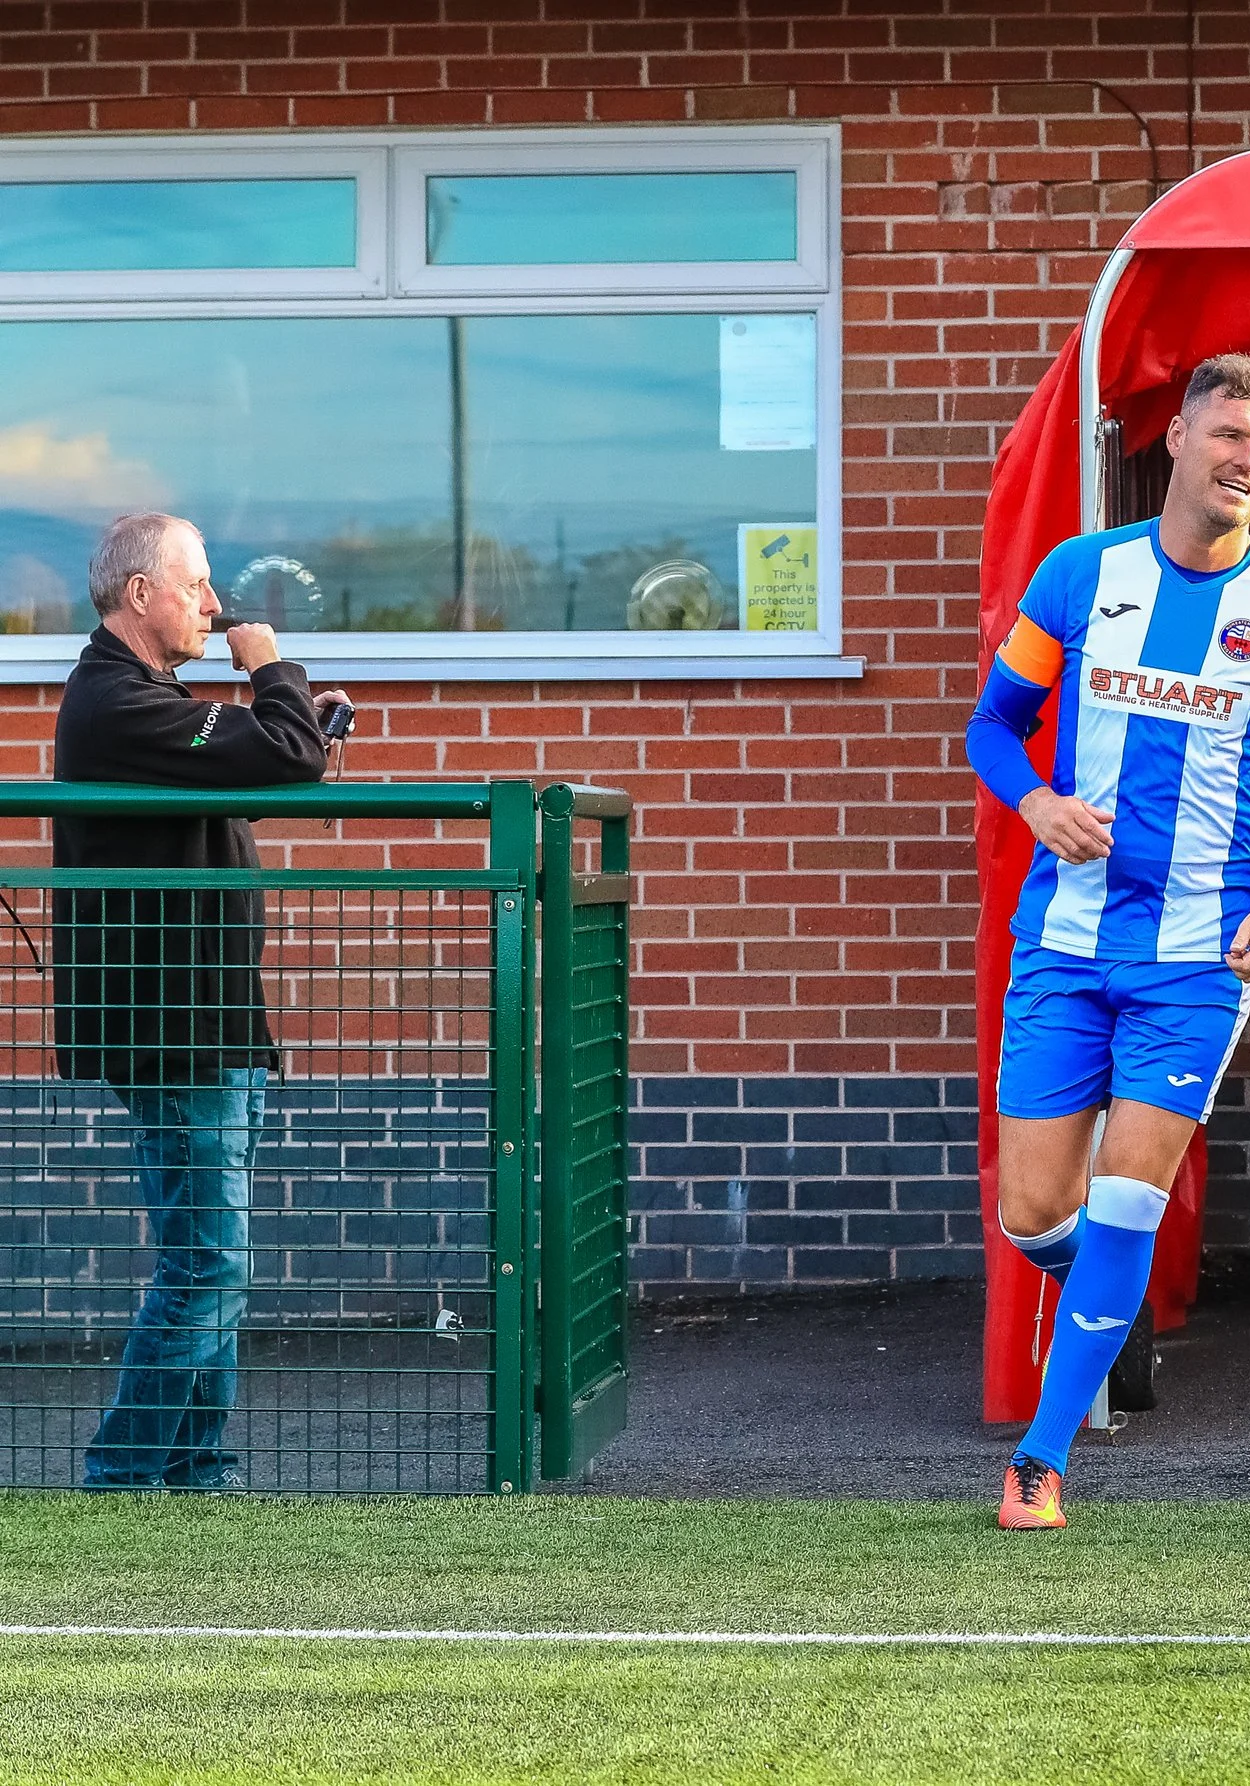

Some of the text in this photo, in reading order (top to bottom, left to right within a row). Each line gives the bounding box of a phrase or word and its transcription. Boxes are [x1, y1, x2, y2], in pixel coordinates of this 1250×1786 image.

[772, 569, 797, 580] This
[753, 583, 816, 595] property is
[748, 596, 804, 608] protected
[763, 608, 807, 619] 24 hour
[1089, 667, 1243, 715] STUART
[1093, 691, 1230, 722] PLUMBING & HEATING SUPPLIES
[200, 702, 224, 739] NEOVIA
